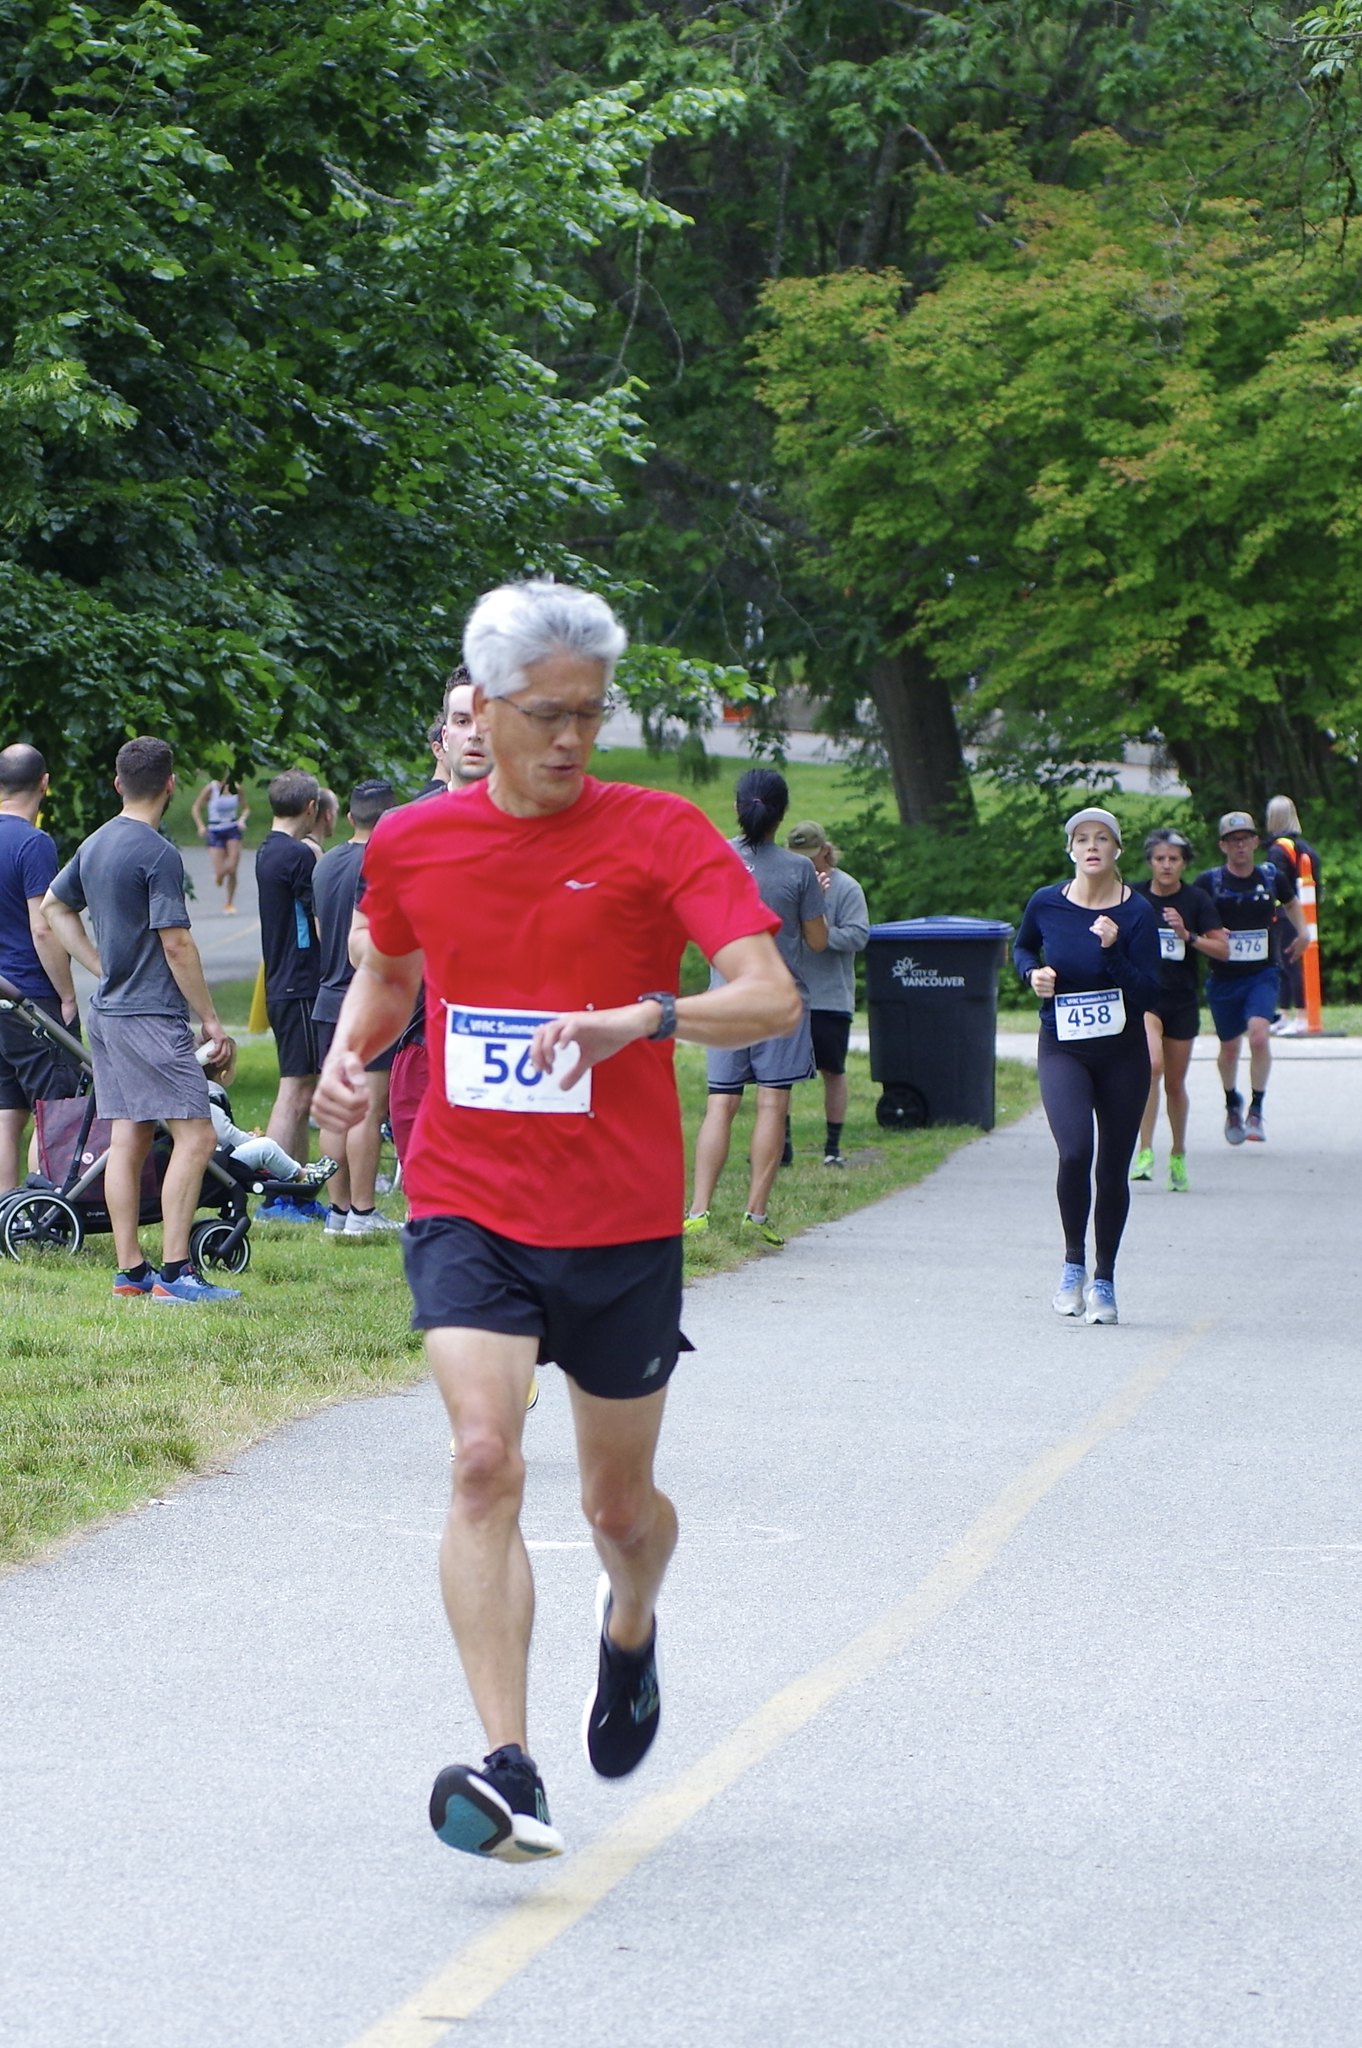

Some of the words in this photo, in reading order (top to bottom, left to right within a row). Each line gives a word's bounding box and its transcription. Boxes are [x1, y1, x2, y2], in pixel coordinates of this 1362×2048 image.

[1235, 939, 1262, 953] 476
[902, 976, 965, 987] VANCOUVER
[1067, 1005, 1112, 1027] 458
[484, 1043, 543, 1086] 56
